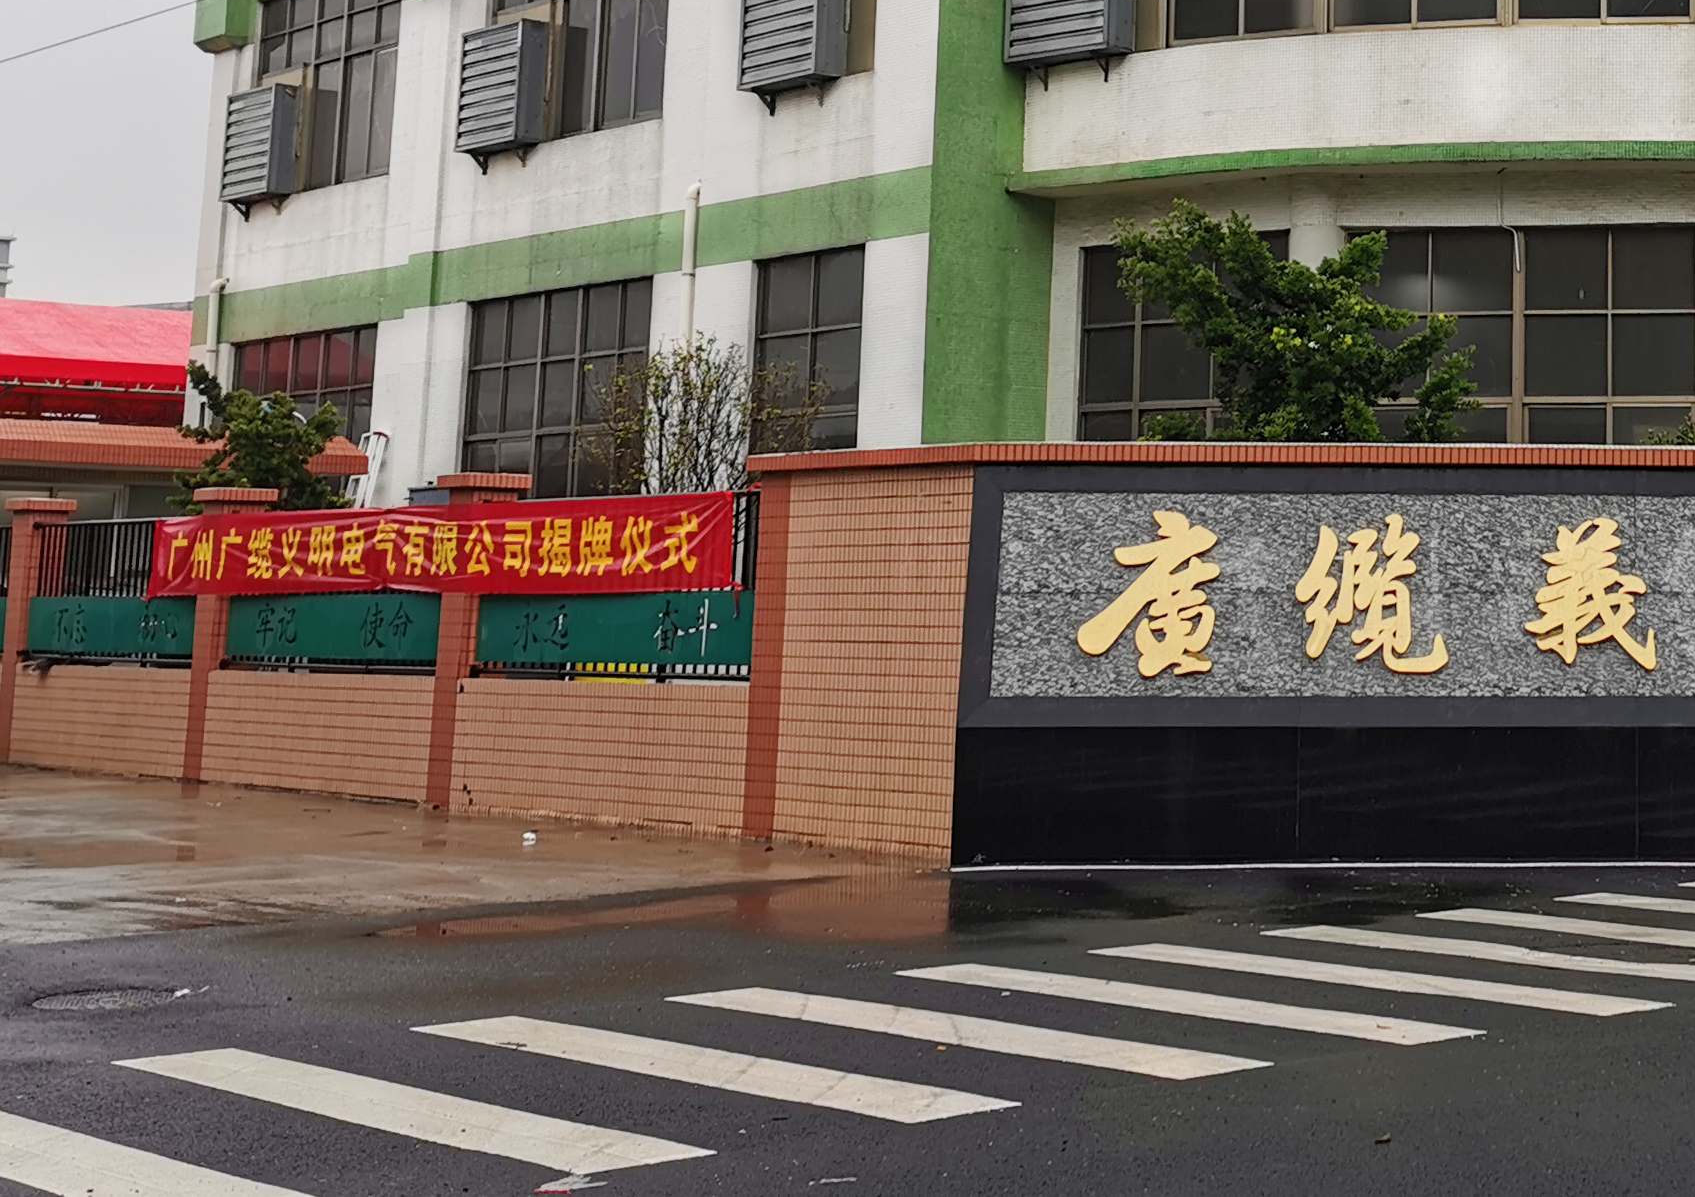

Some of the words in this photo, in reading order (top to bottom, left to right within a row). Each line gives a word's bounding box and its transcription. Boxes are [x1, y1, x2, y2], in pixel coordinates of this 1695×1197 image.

[167, 512, 698, 581] 广州广缆义明电气有限公司揭牌仪式
